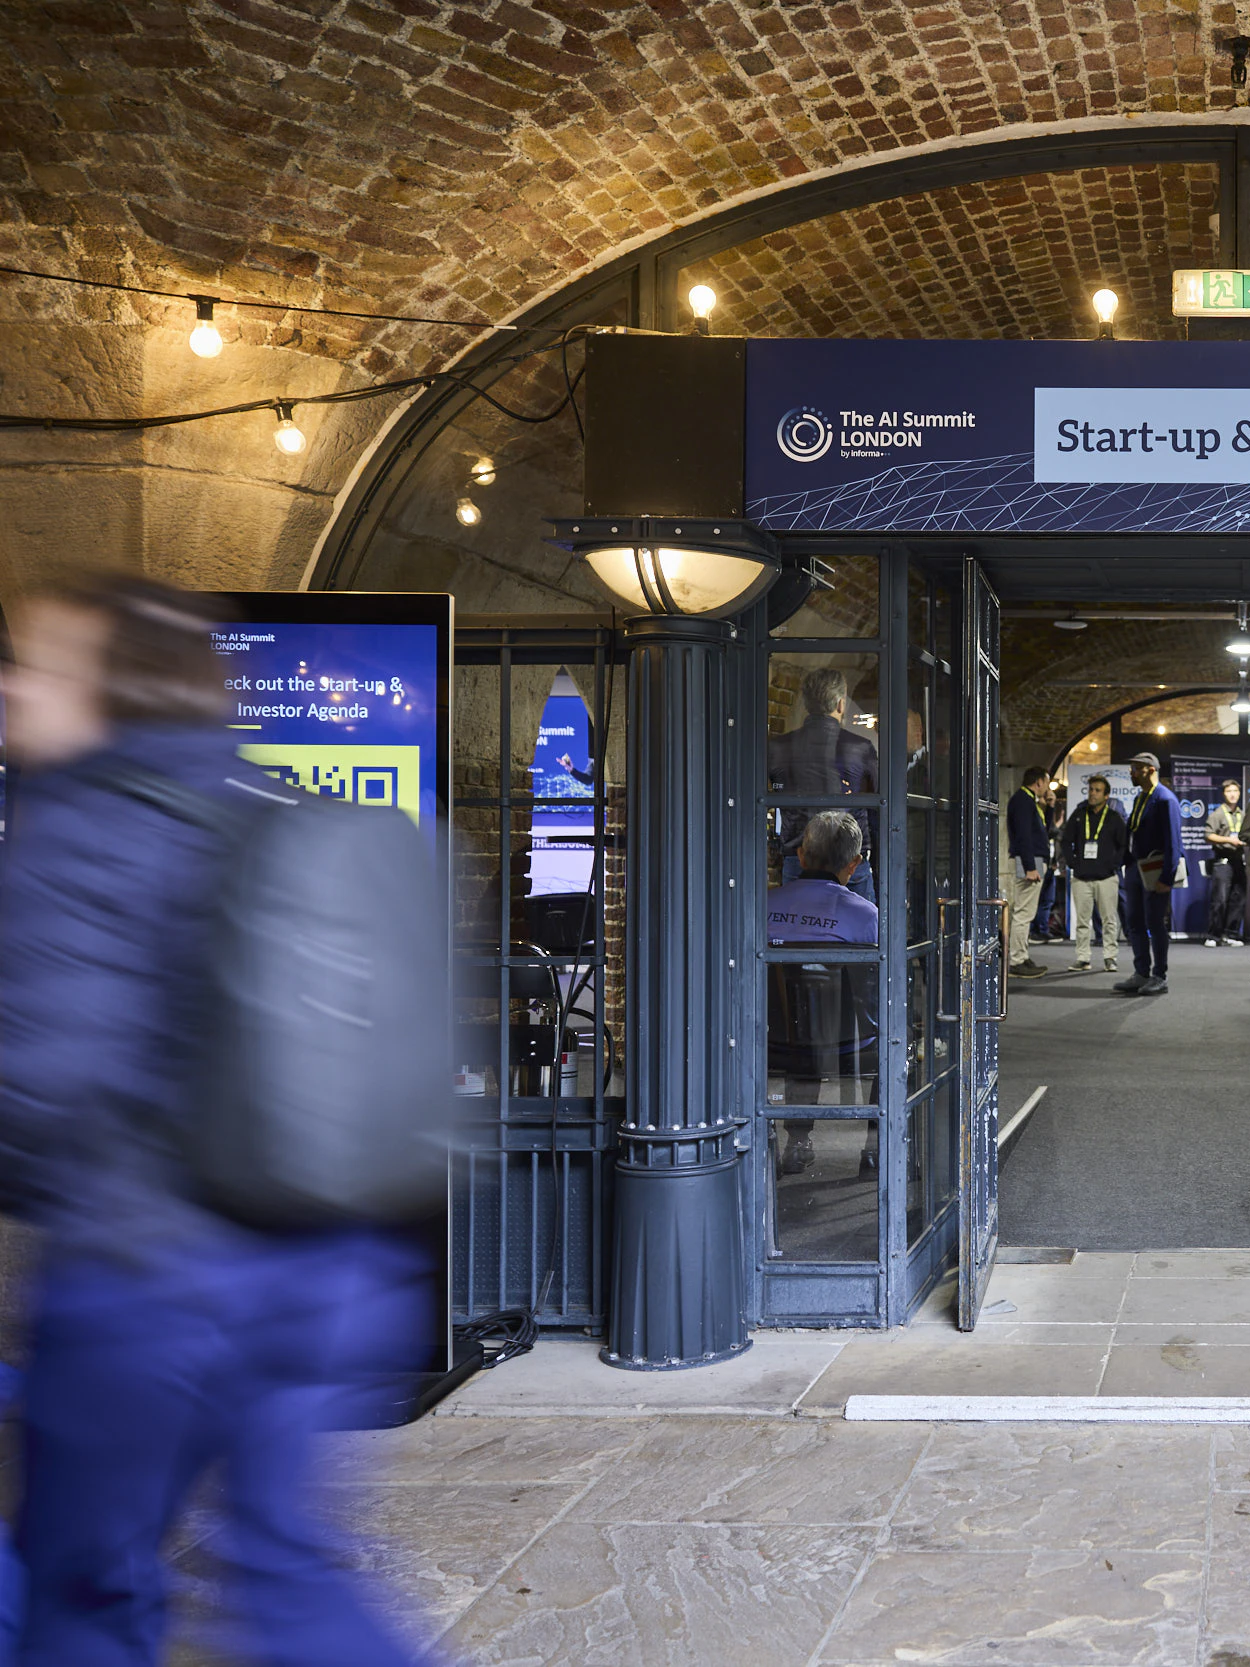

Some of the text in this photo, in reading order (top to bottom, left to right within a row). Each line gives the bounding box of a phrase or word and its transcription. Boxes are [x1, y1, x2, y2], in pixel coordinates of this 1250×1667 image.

[840, 411, 976, 427] The AI Summit
[840, 431, 922, 447] LONDON
[1057, 419, 1221, 460] Start-up
[840, 450, 850, 458] by
[210, 633, 275, 642] The AI Summit
[210, 642, 250, 651] LONDON
[255, 678, 283, 691] out
[287, 676, 315, 691] the
[319, 676, 385, 696] Start-up
[390, 676, 403, 692] &
[238, 702, 369, 721] Investor Agenda
[800, 915, 839, 929] STAFF
